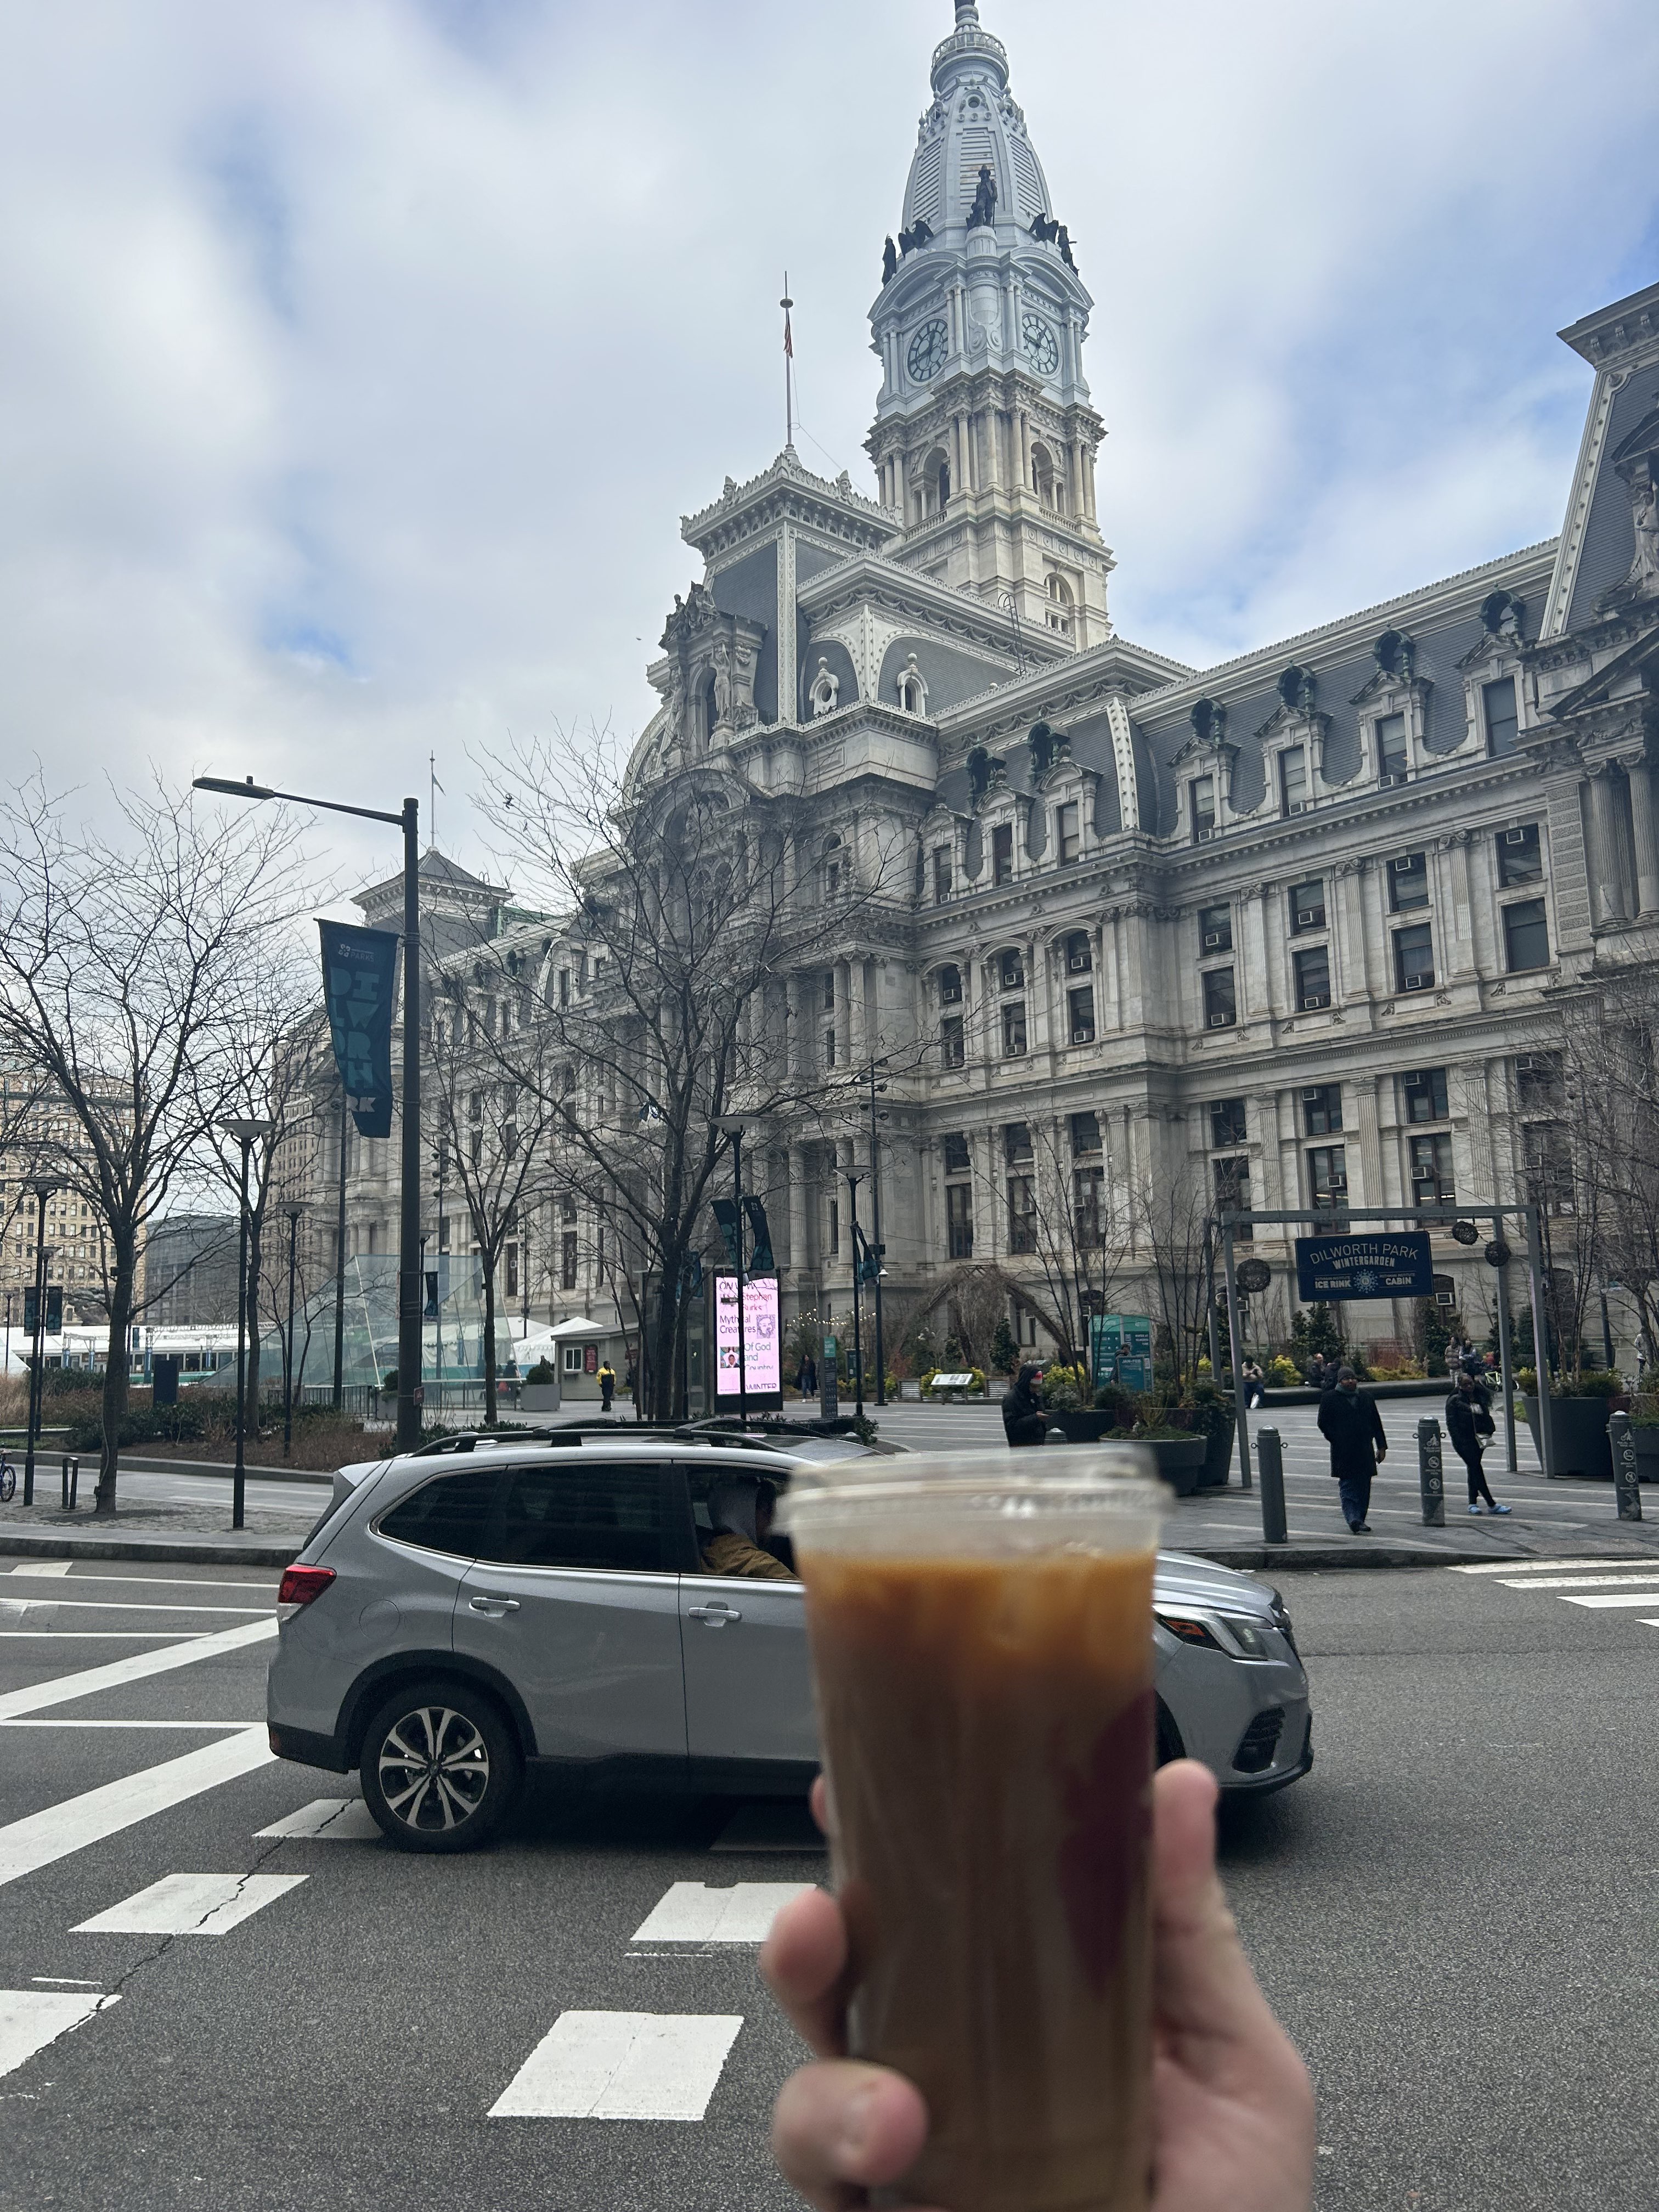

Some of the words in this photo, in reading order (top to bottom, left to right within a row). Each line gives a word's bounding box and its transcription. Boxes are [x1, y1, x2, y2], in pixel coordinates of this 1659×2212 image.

[351, 952, 374, 962] PARKS
[1310, 1243, 1378, 1264] DILWORTH
[1383, 1244, 1419, 1260] PARK
[1332, 1256, 1395, 1269] WINTERGARDEN
[1315, 1280, 1329, 1289] ICE
[1330, 1280, 1351, 1288] RINK
[1385, 1277, 1412, 1285] CABIN
[720, 1314, 751, 1324] Mythal
[720, 1325, 756, 1334] Creares
[744, 1342, 754, 1351] Of
[755, 1342, 771, 1351] God
[744, 1352, 758, 1361] and
